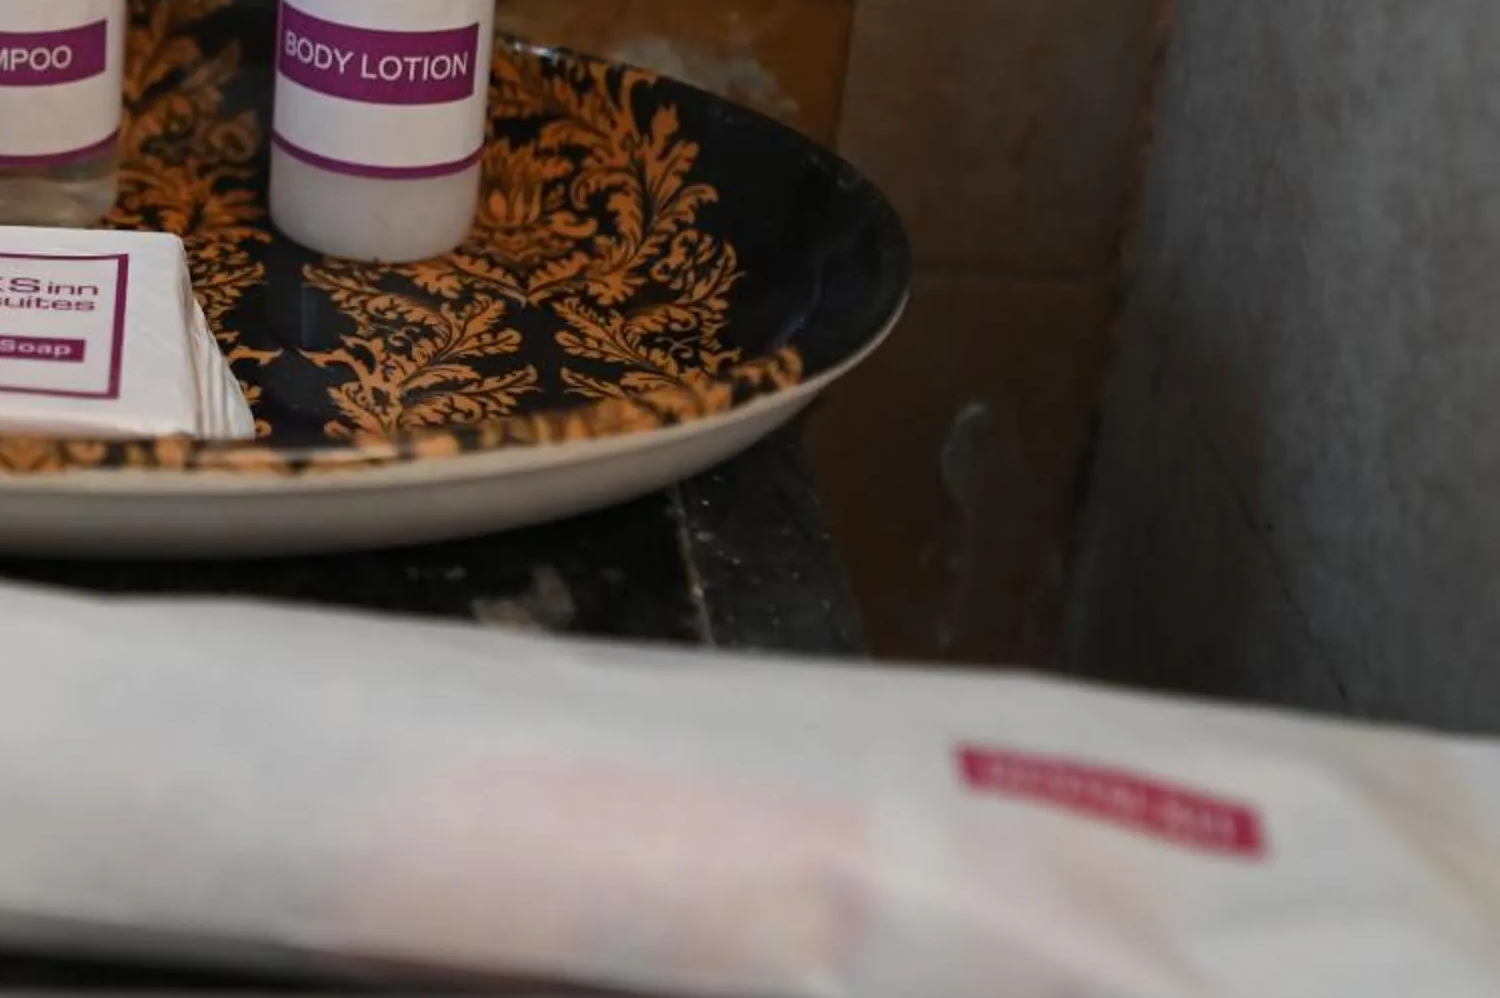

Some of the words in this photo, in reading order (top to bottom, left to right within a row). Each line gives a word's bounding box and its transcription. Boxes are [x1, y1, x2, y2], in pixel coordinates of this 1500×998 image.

[284, 29, 355, 75] BODY
[360, 51, 469, 82] LOTION
[47, 280, 100, 296] inn
